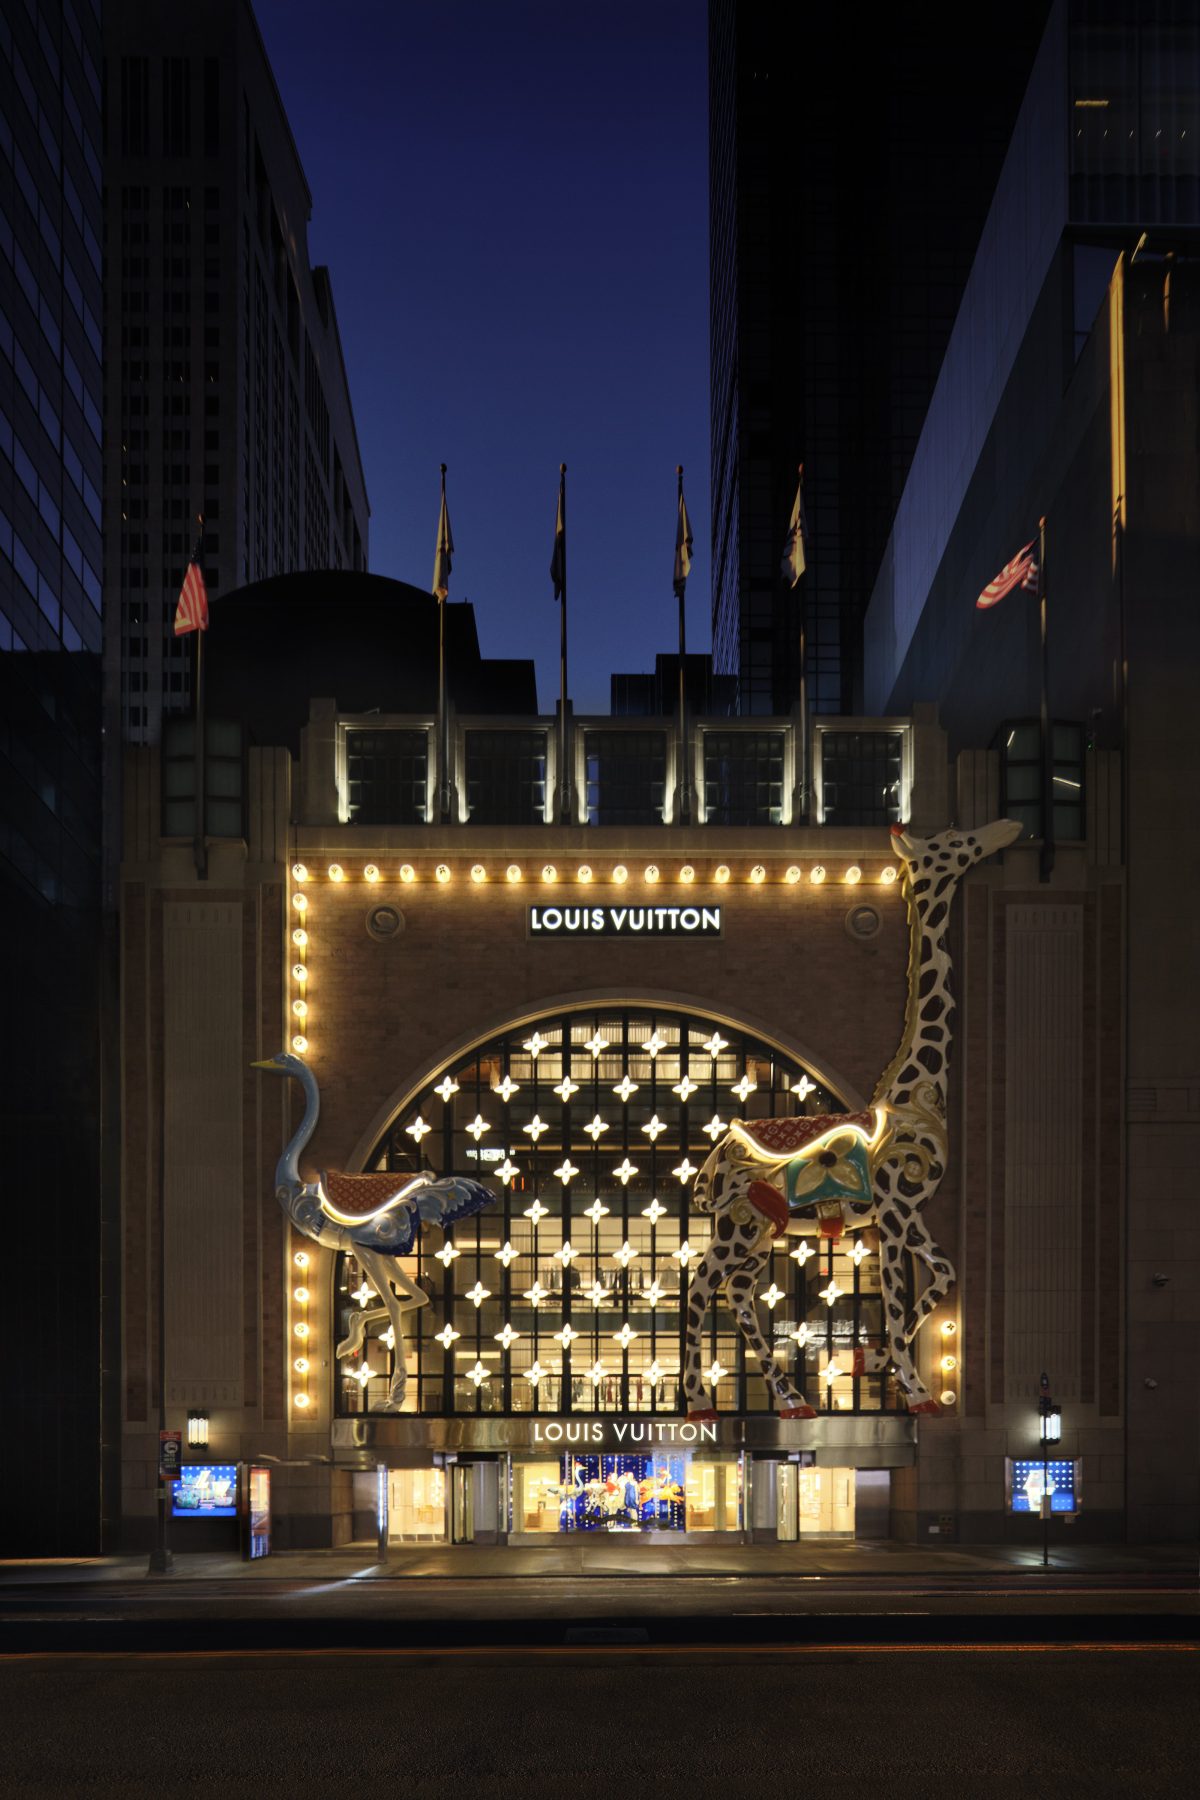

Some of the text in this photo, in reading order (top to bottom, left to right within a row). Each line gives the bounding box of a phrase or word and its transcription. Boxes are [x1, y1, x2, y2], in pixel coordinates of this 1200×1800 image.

[532, 909, 720, 930] LOUIS VUITTON
[534, 1422, 717, 1442] LOUIS VUITTON
